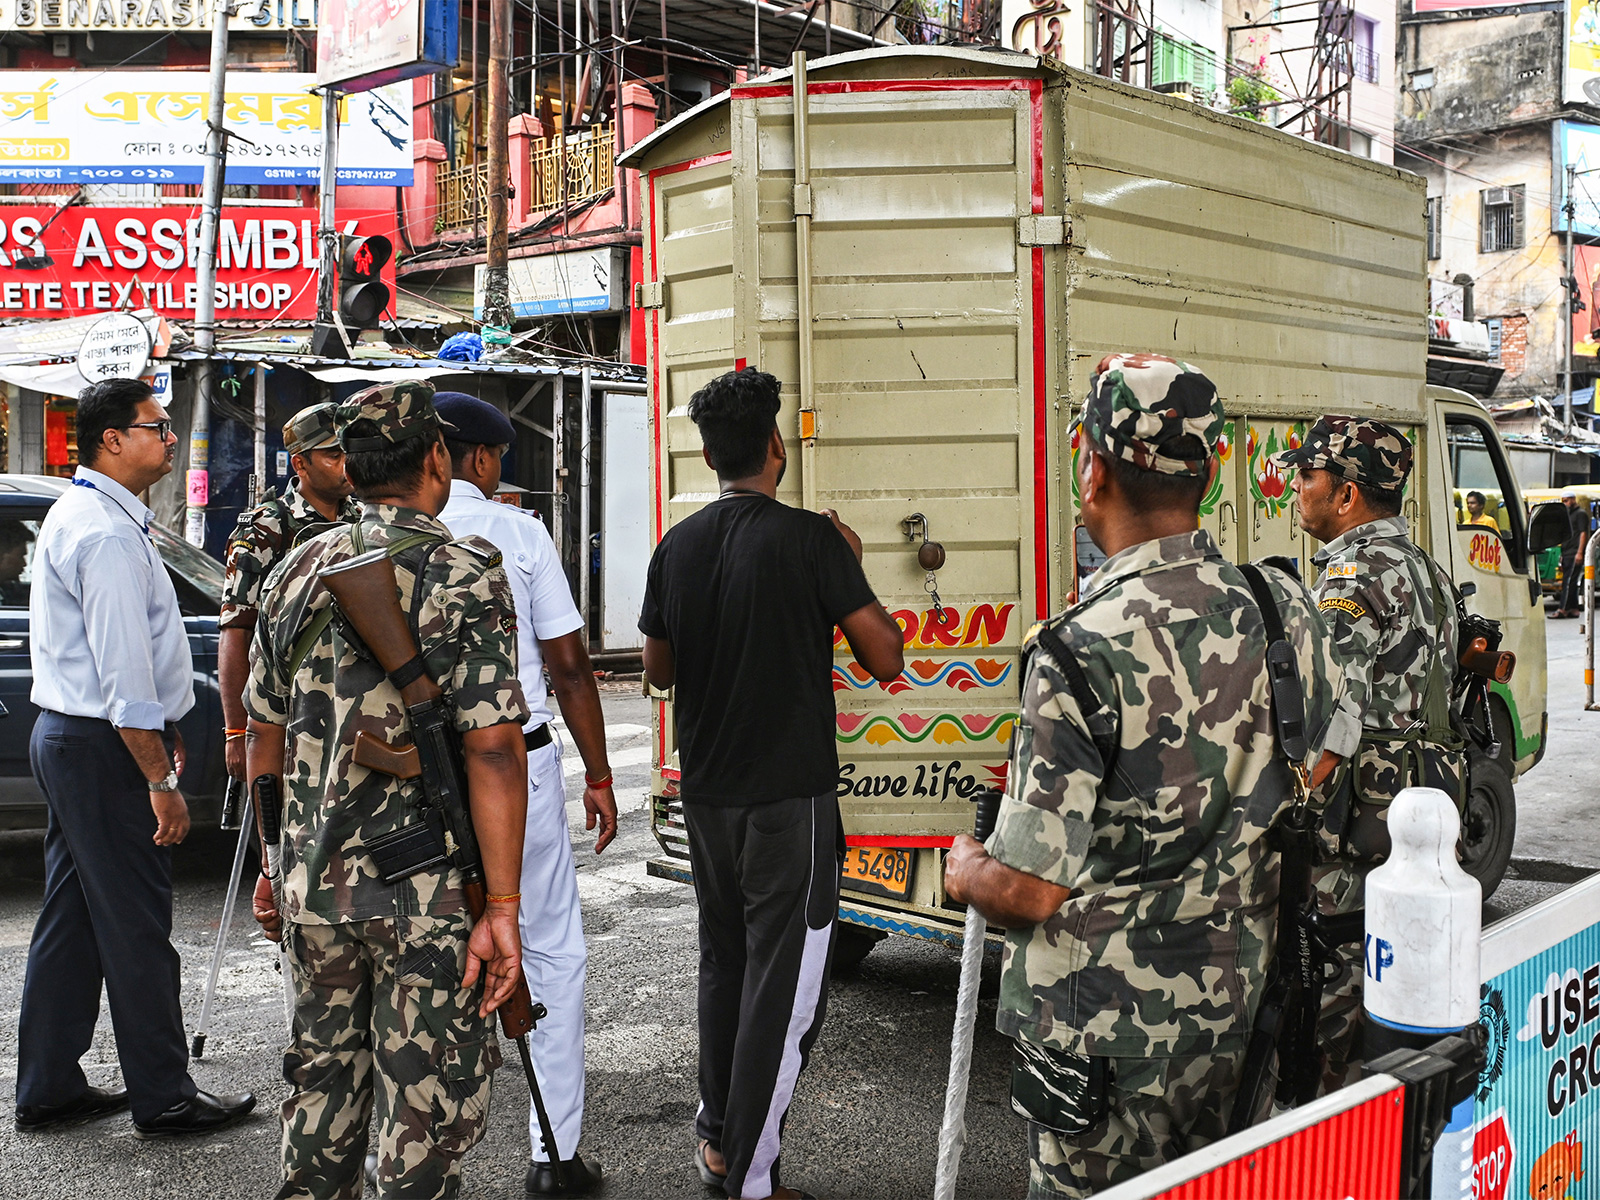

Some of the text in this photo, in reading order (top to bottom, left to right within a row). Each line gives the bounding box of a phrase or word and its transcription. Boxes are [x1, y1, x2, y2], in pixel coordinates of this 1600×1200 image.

[15, 0, 208, 27] BENARASI
[707, 118, 727, 144] WB
[264, 169, 296, 178] GSTIN
[0, 282, 63, 309] ETE
[1467, 533, 1502, 573] Pilot
[836, 760, 986, 803] Save Life
[857, 849, 907, 883] 5498
[1541, 964, 1600, 1050] USE
[1472, 1145, 1505, 1200] STOP
